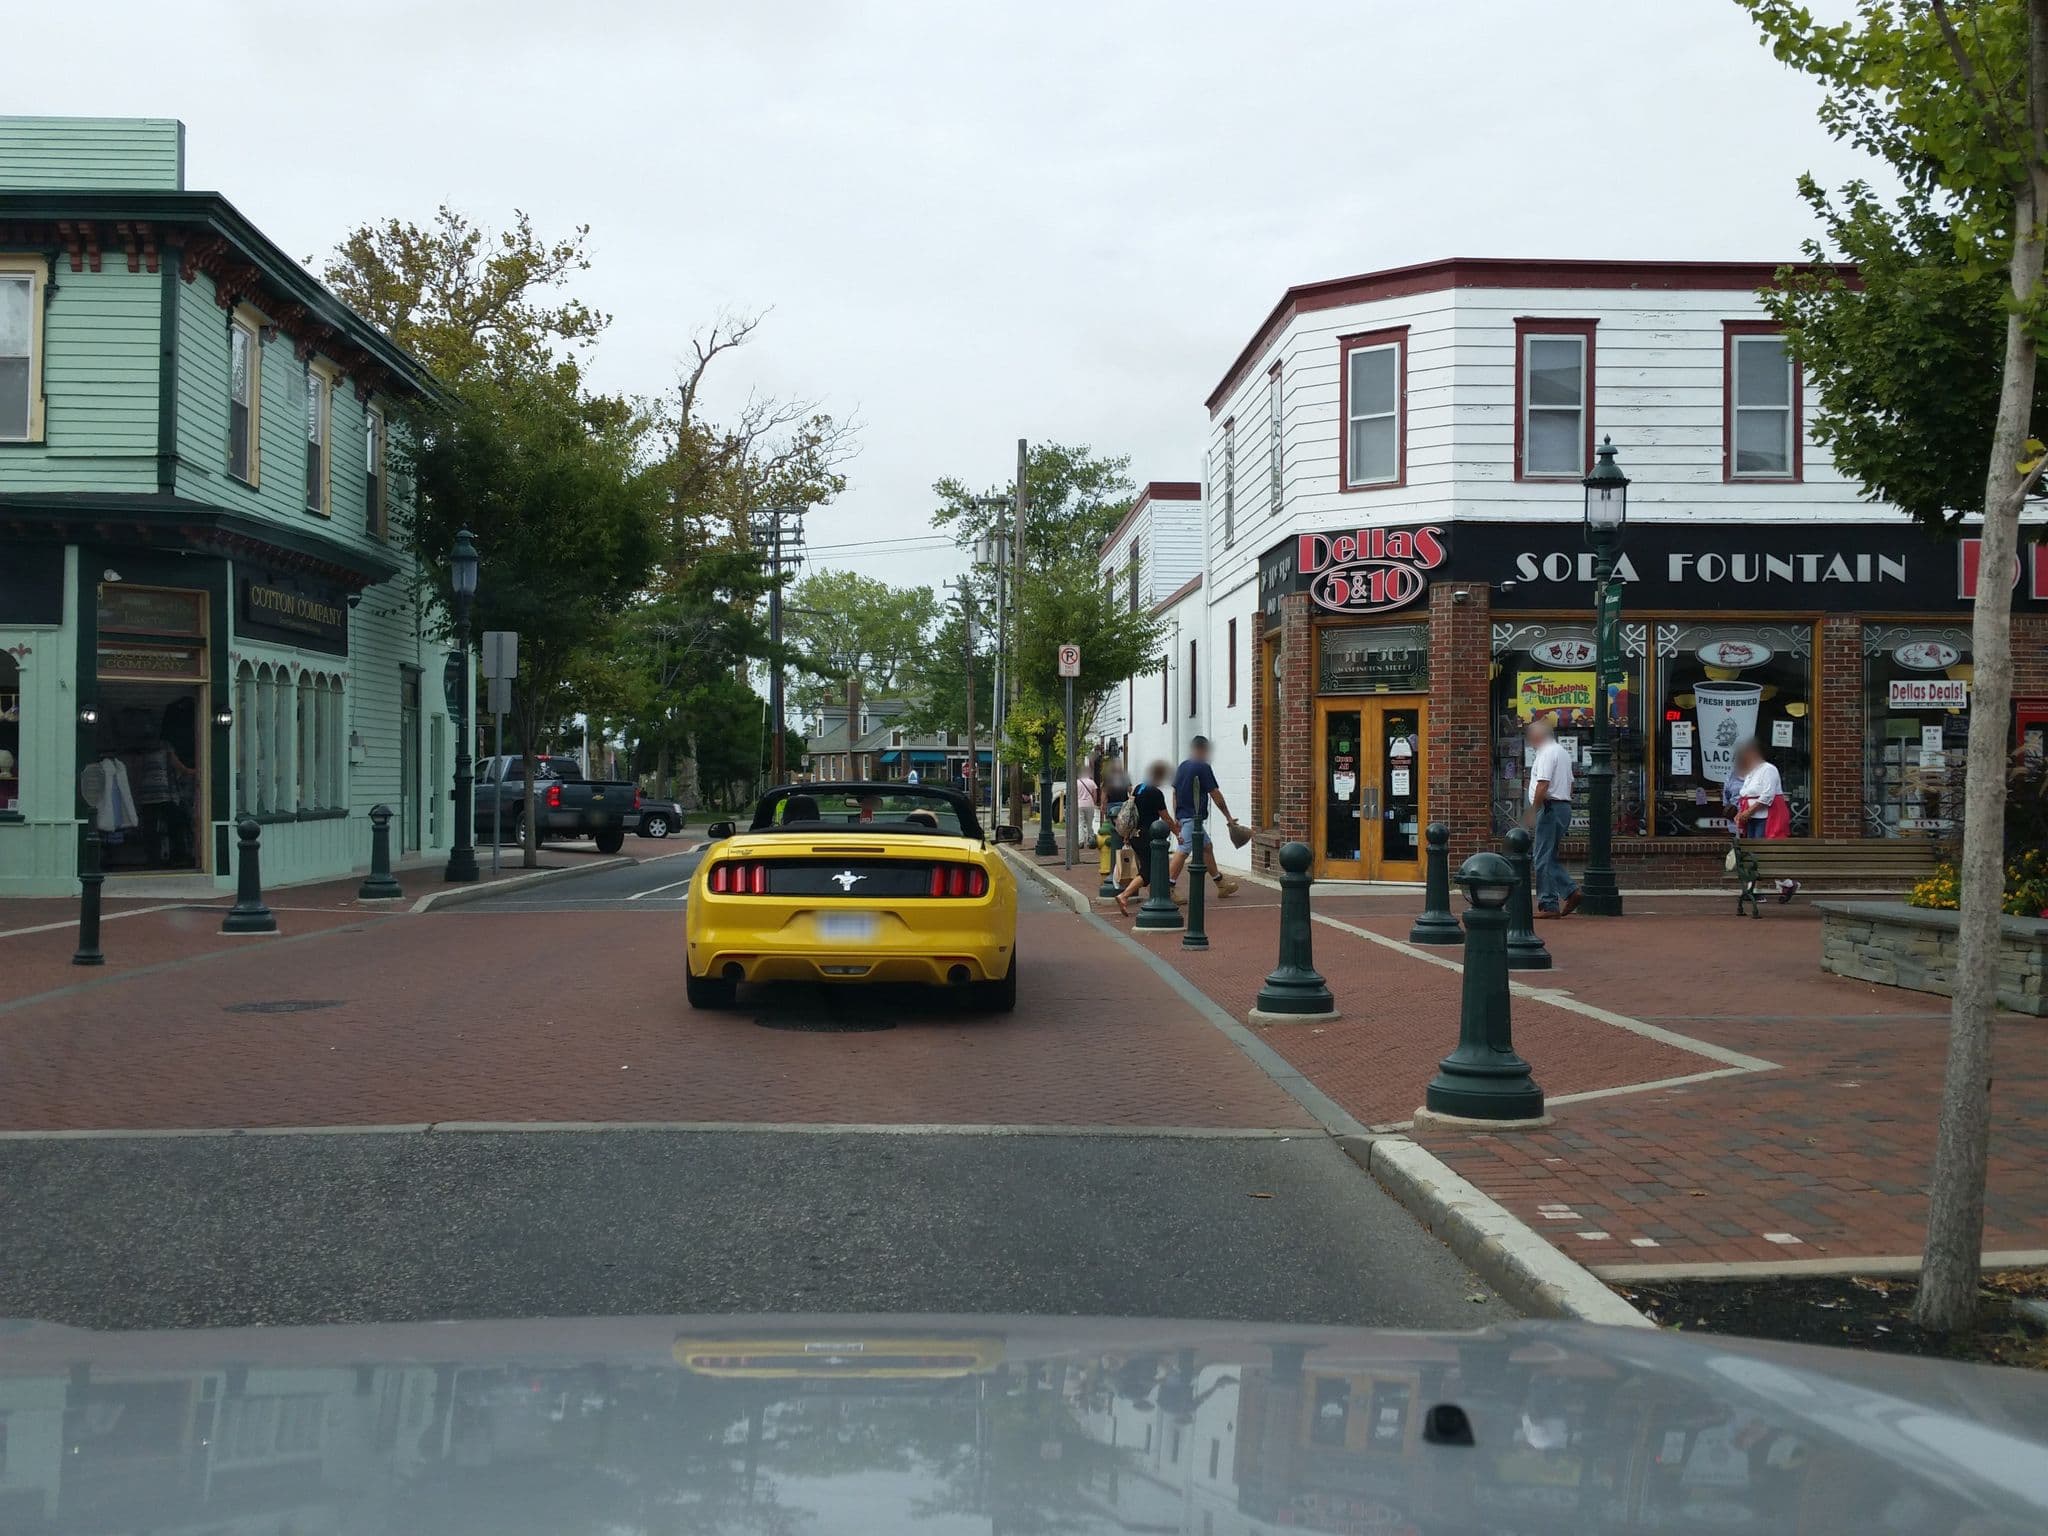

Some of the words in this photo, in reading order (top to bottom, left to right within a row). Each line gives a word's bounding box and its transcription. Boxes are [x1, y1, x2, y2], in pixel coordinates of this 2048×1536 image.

[1516, 553, 1640, 582] SODA
[1668, 553, 1906, 583] FOUNTAIN
[1323, 567, 1412, 606] 5&10
[251, 585, 295, 615] COTTON
[297, 599, 342, 625] COMPANY
[1537, 684, 1588, 697] Philadelphia
[1537, 692, 1571, 704] WATER
[1573, 691, 1590, 704] ICE
[1698, 696, 1723, 706] FRESH
[1726, 698, 1758, 706] BREWED
[1704, 750, 1735, 762] LAC
